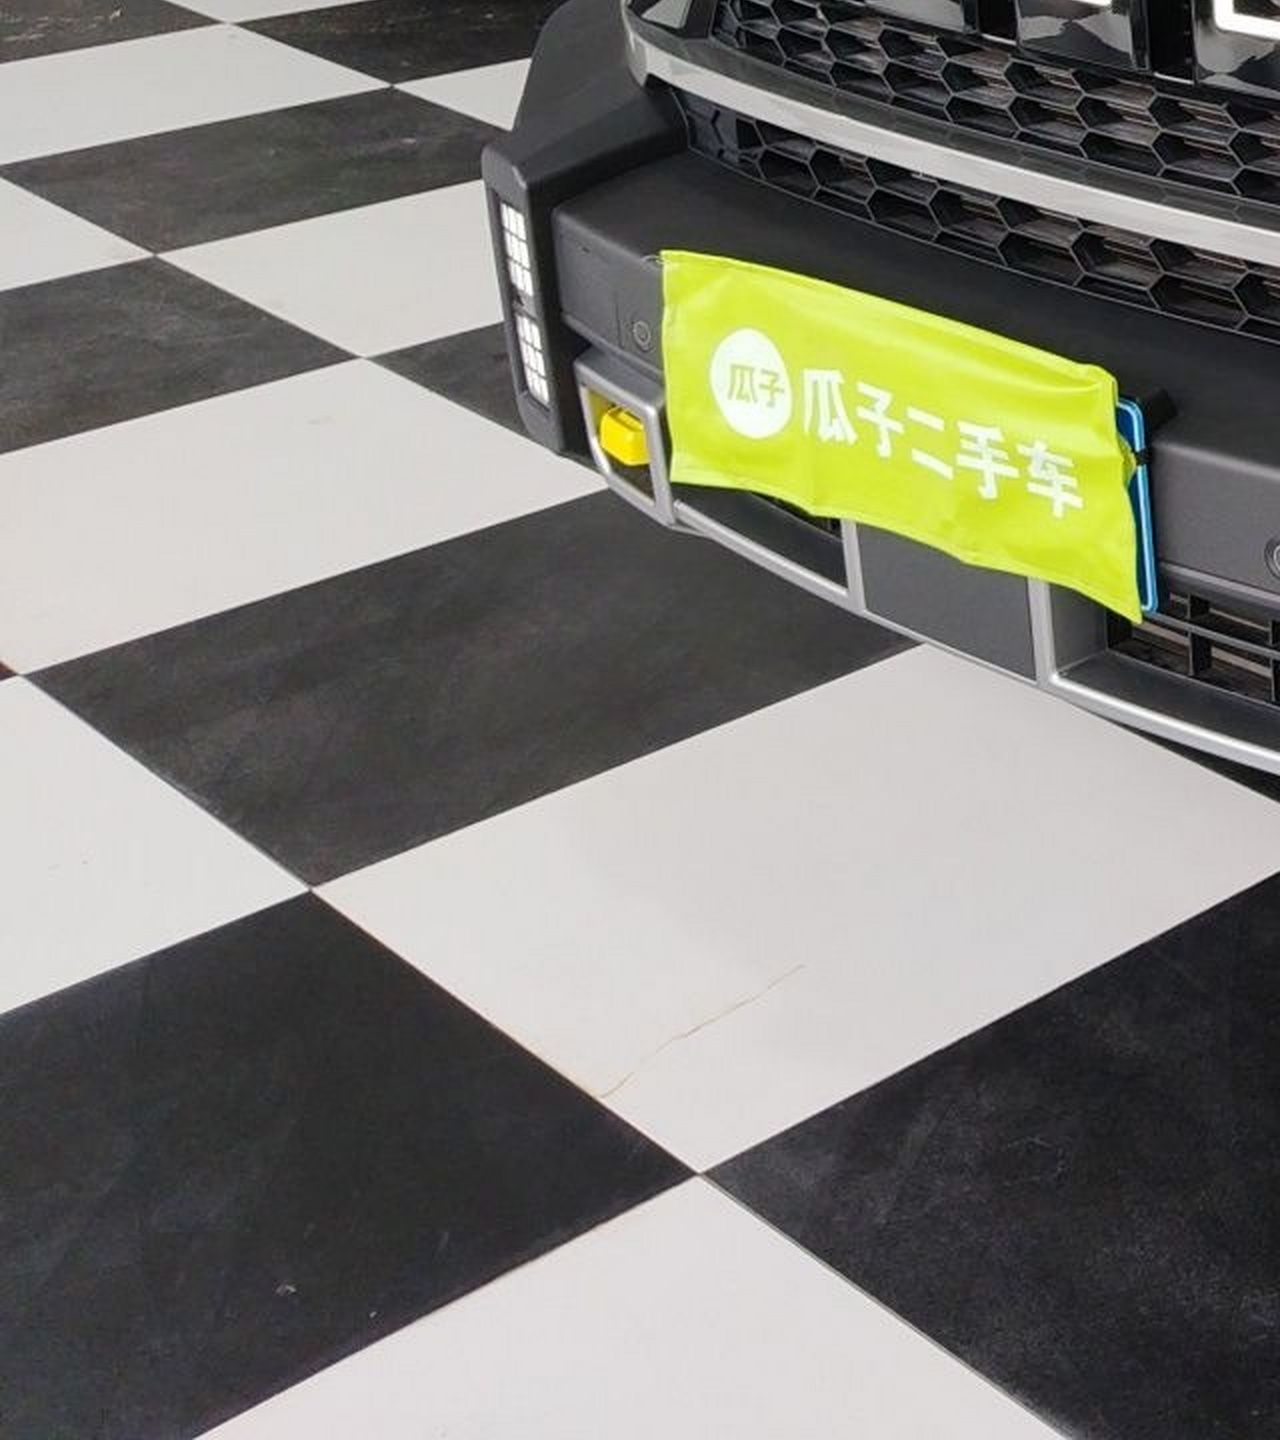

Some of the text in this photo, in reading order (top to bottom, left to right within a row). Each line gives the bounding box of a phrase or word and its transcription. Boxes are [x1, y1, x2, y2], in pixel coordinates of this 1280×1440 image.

[726, 362, 785, 409] 瓜子
[801, 367, 1085, 519] 瓜子二手车
